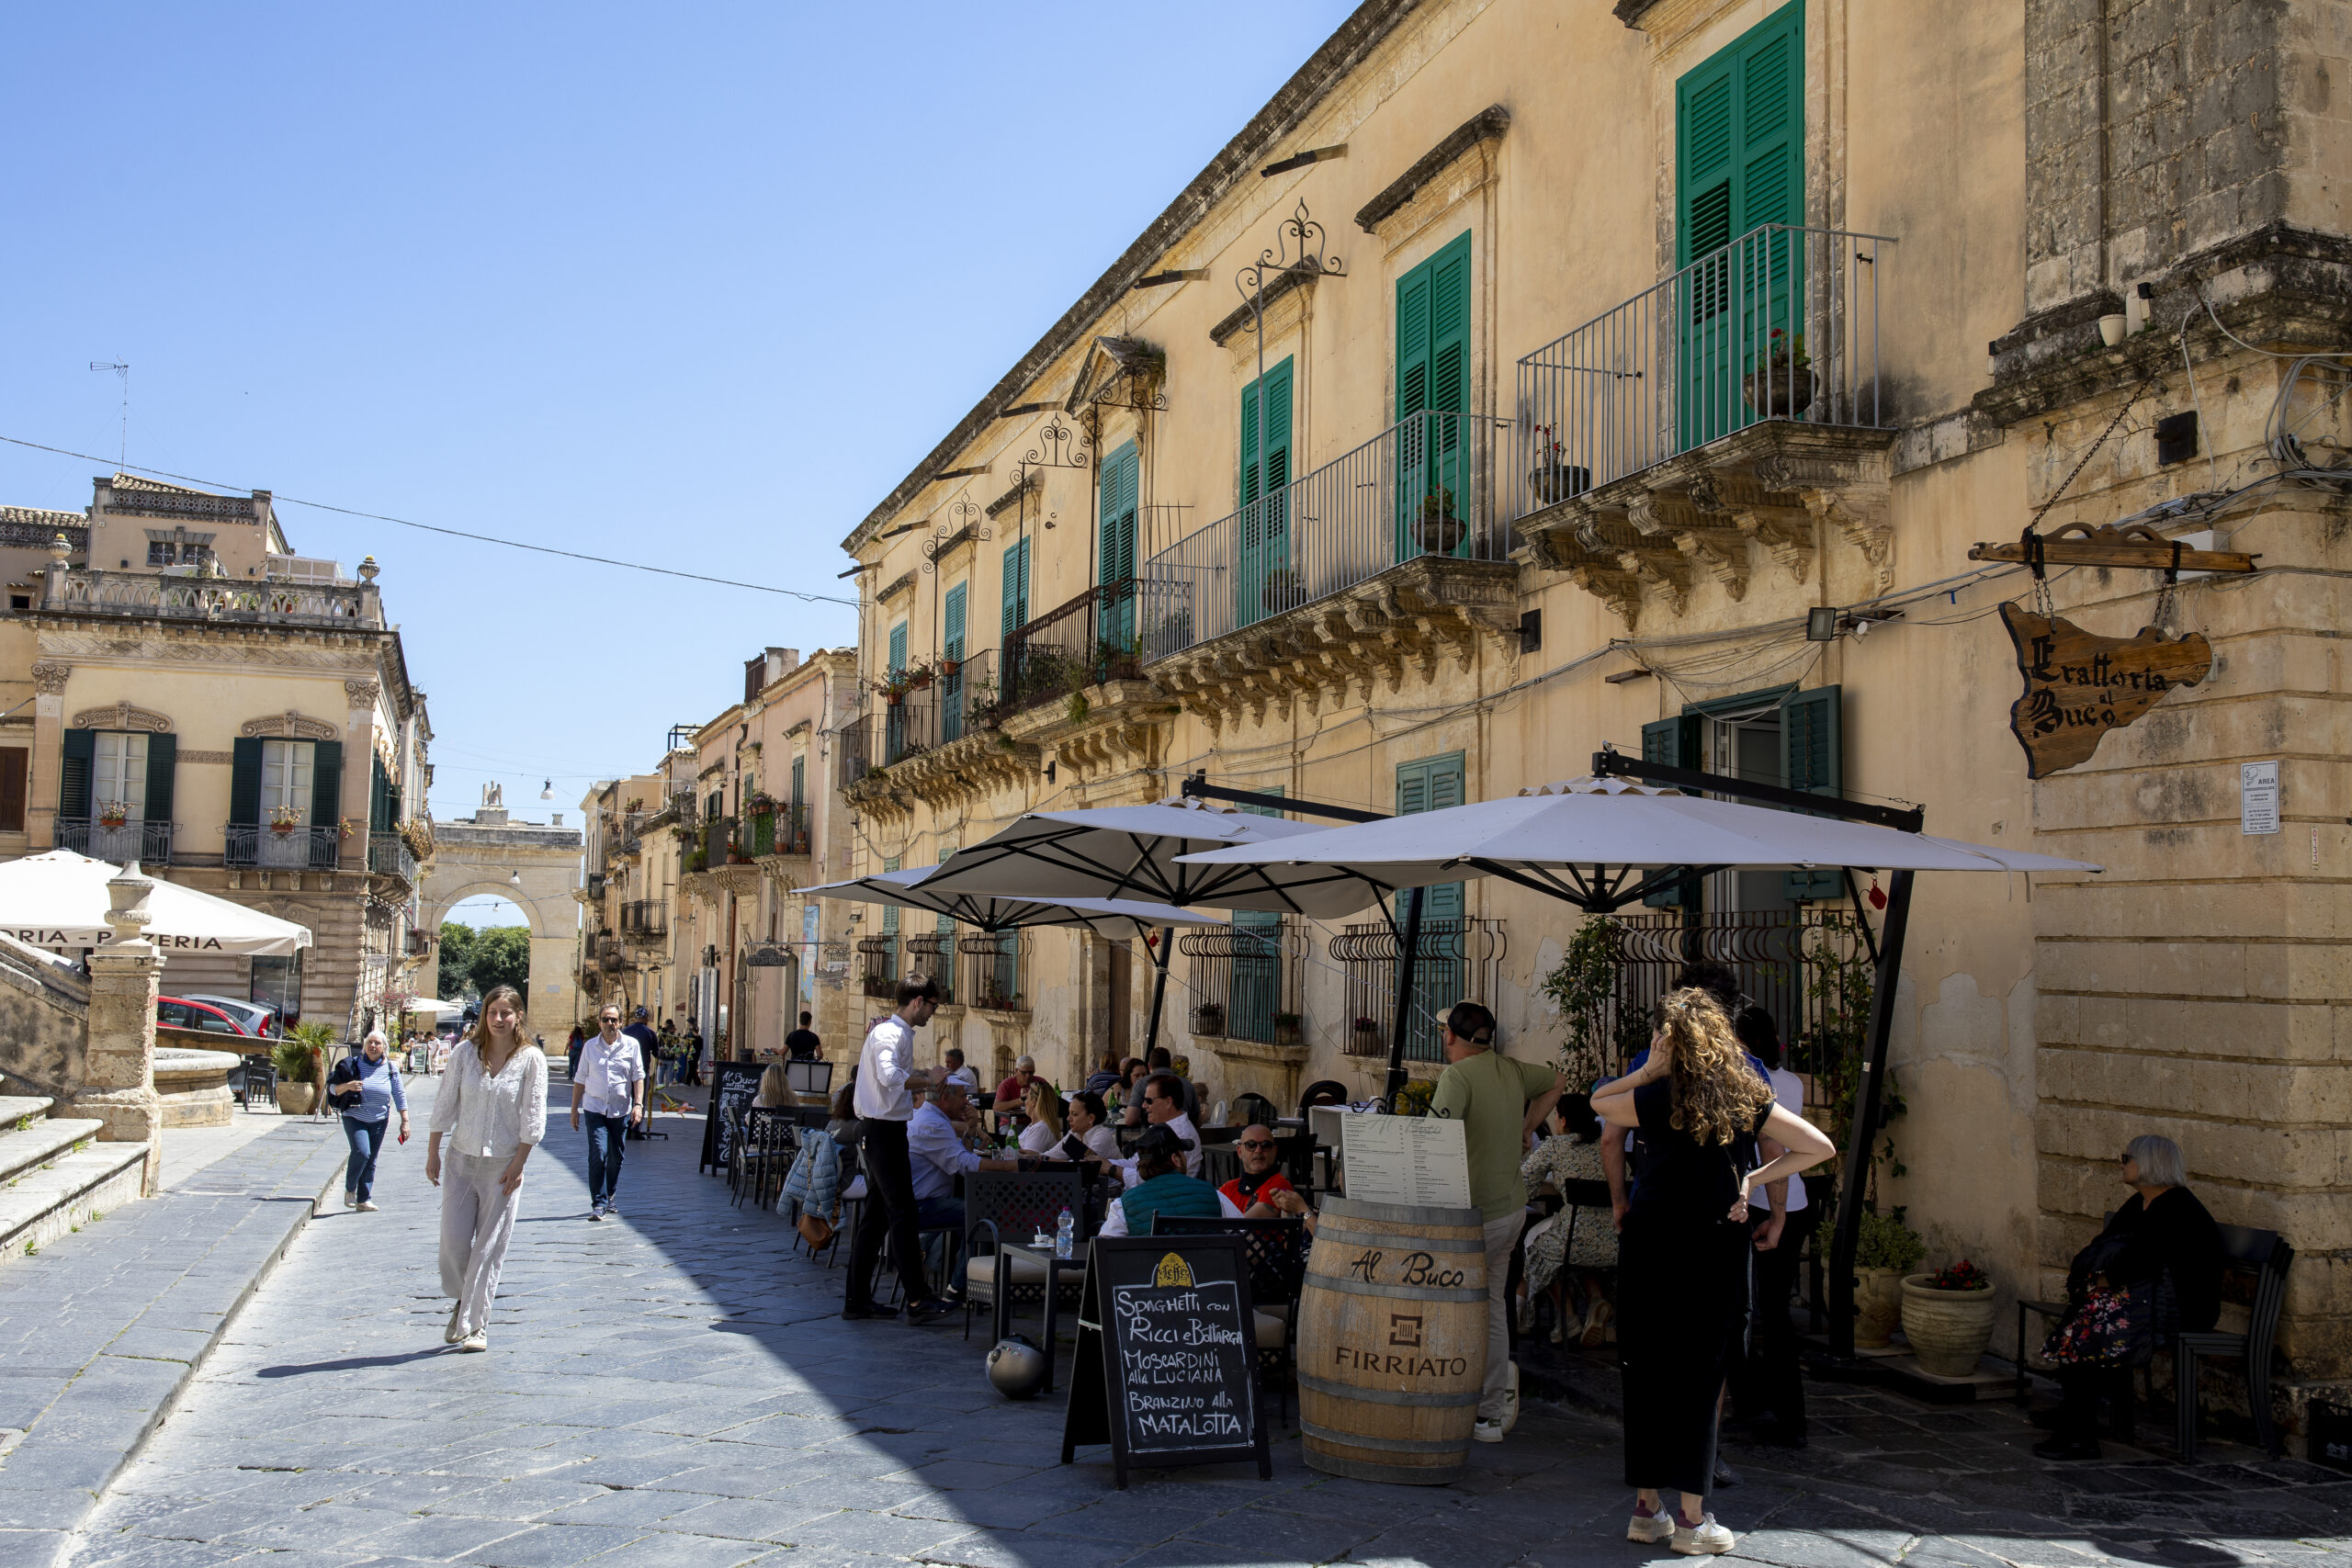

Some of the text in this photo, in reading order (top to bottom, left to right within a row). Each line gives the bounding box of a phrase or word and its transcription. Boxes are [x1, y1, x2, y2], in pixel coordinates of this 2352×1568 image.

[2030, 635, 2167, 691] Trattoria
[2098, 690, 2114, 705] al
[2028, 686, 2116, 733] Buco
[2257, 777, 2275, 785] AREA
[96, 931, 222, 951] PZERIA
[1351, 1249, 1464, 1287] Al Buco
[1335, 1346, 1466, 1377] FIRRIATO
[1153, 1368, 1223, 1383] LUCIANA
[1129, 1391, 1204, 1412] BRANZINO
[1138, 1411, 1242, 1437] MATALOTTA
